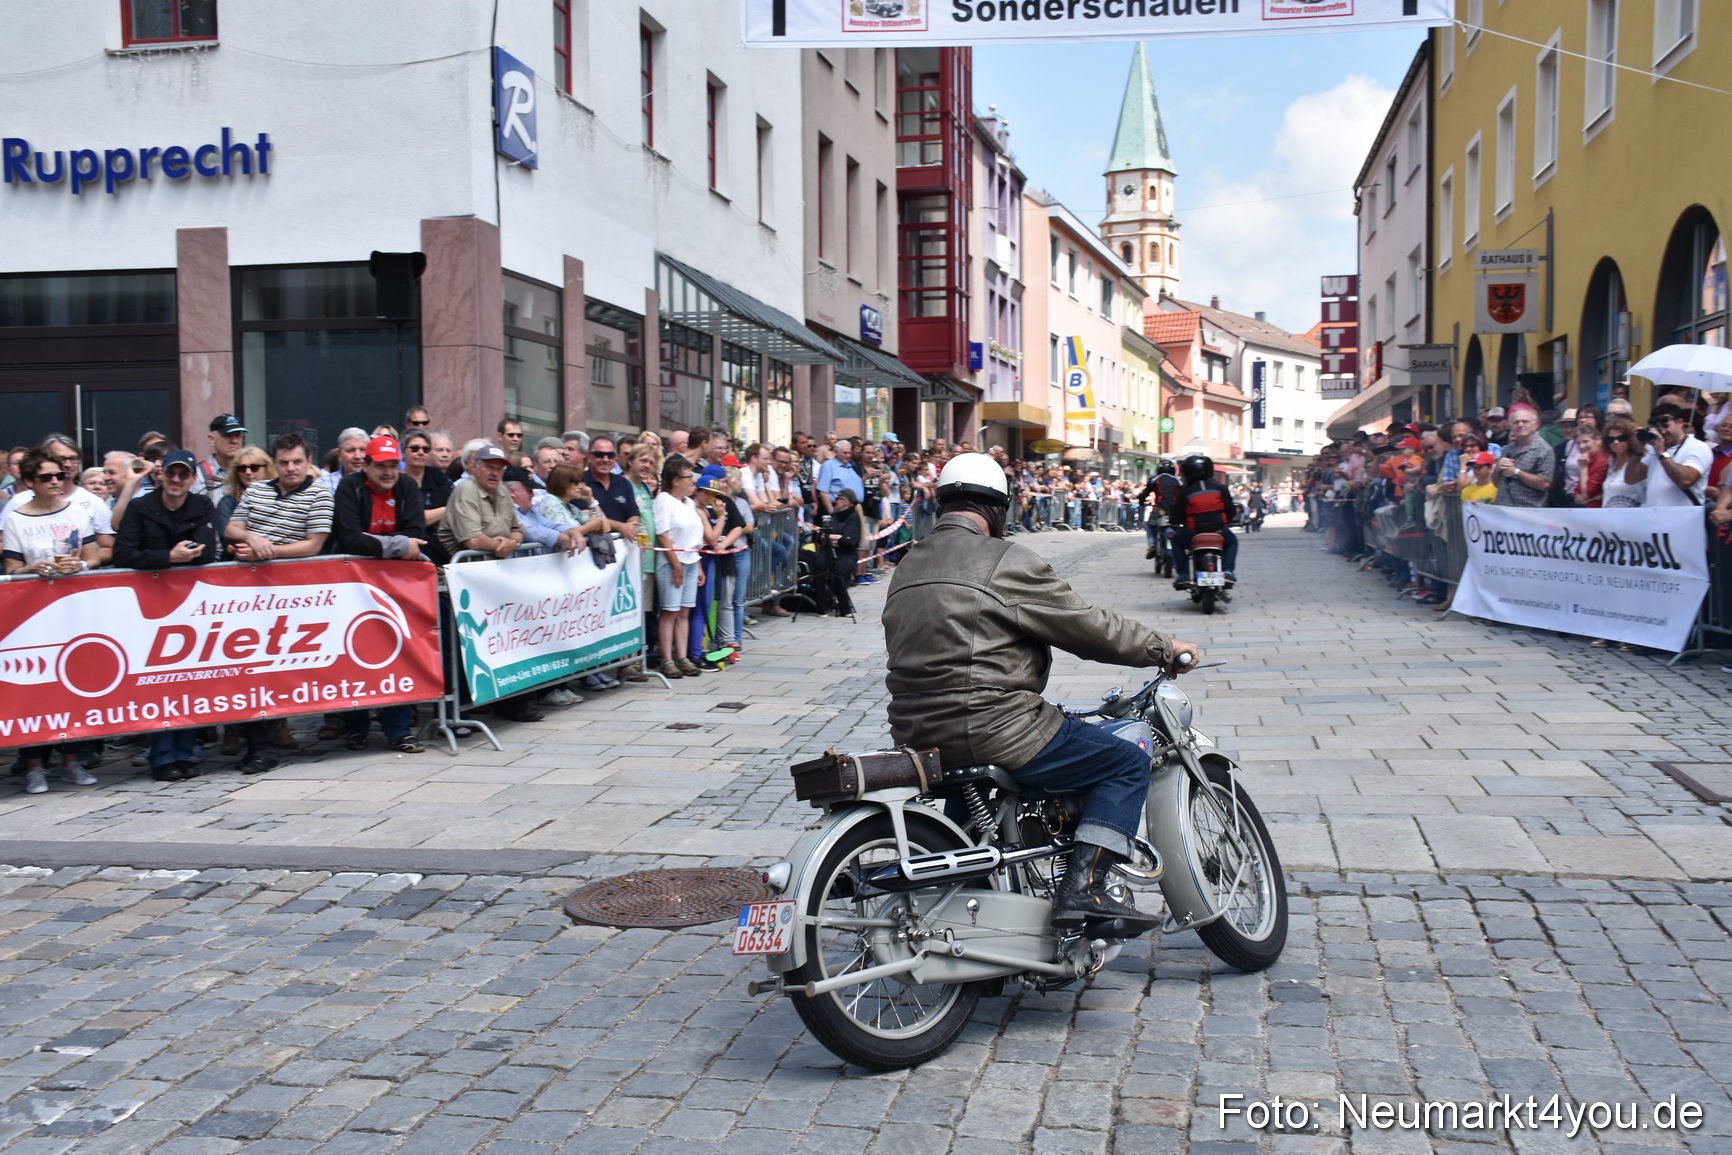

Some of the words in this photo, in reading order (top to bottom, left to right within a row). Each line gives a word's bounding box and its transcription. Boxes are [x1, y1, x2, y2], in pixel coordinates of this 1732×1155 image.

[952, 0, 1239, 22] Sonderschauen
[502, 71, 537, 153] R
[2, 127, 271, 194] Rupprecht
[1481, 254, 1525, 264] RATHAUS
[1323, 277, 1348, 372] WITT
[1441, 360, 1448, 369] K
[1070, 373, 1082, 387] B
[1322, 379, 1356, 390] WITT
[1483, 527, 1682, 570] neumarktaktuell
[1484, 564, 1499, 576] DAS
[1500, 567, 1585, 585] NACHRICHTENPORTAL
[1587, 573, 1602, 586] FÜR
[1605, 576, 1684, 595] NEUMARKT/OPF.
[190, 590, 338, 617] Autoklassik
[514, 598, 551, 622] UNS
[557, 610, 606, 641] BESSER
[145, 615, 330, 667] Dietz
[135, 667, 244, 686] BREITENBRUNN
[0, 674, 415, 737] www.autoklassik-dietz.de
[748, 904, 778, 927] DEG
[738, 928, 784, 952] 06334
